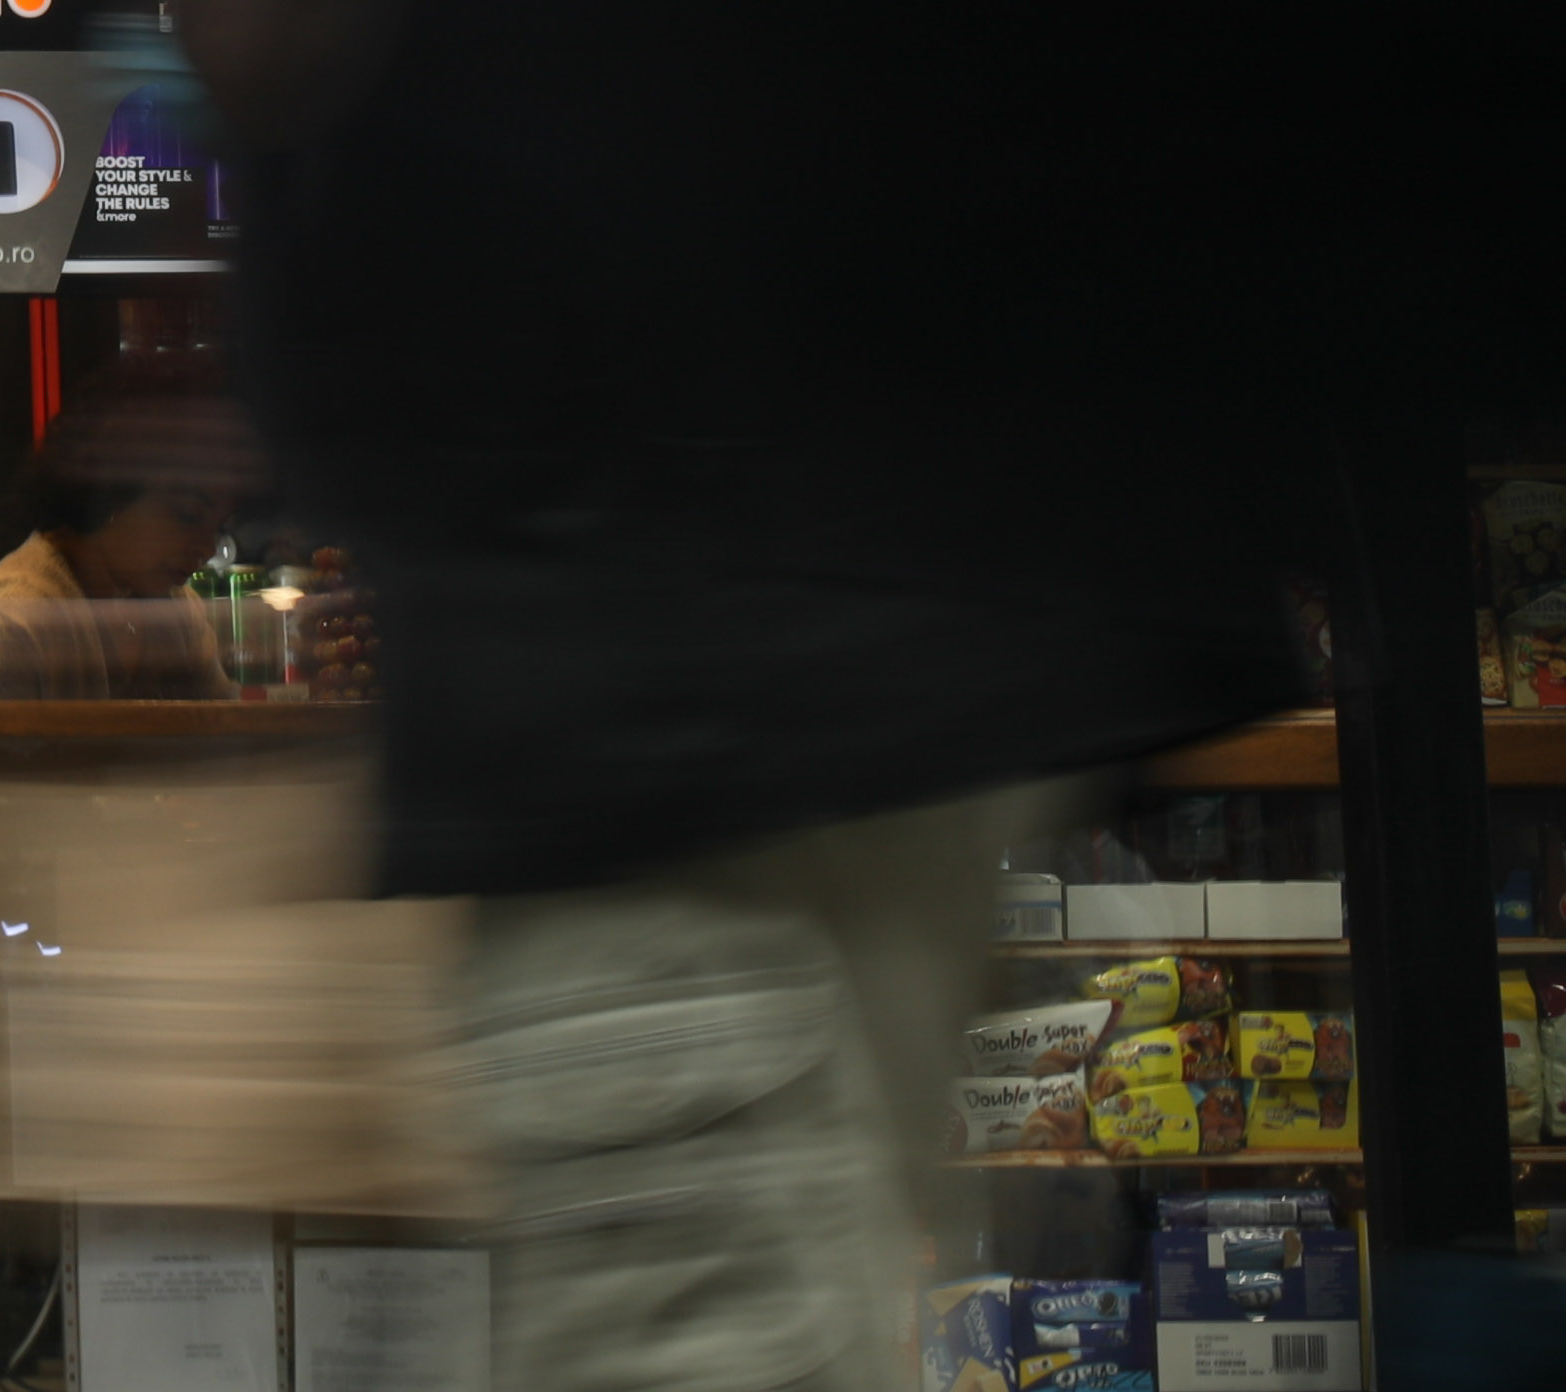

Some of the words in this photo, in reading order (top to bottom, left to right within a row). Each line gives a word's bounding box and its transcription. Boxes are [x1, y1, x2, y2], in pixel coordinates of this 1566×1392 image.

[95, 155, 147, 169] BOOST
[95, 169, 136, 183] YOUR
[138, 169, 182, 183] STYLE
[95, 183, 159, 197] CHANGE
[95, 197, 124, 210] THE
[125, 197, 171, 210] RULES
